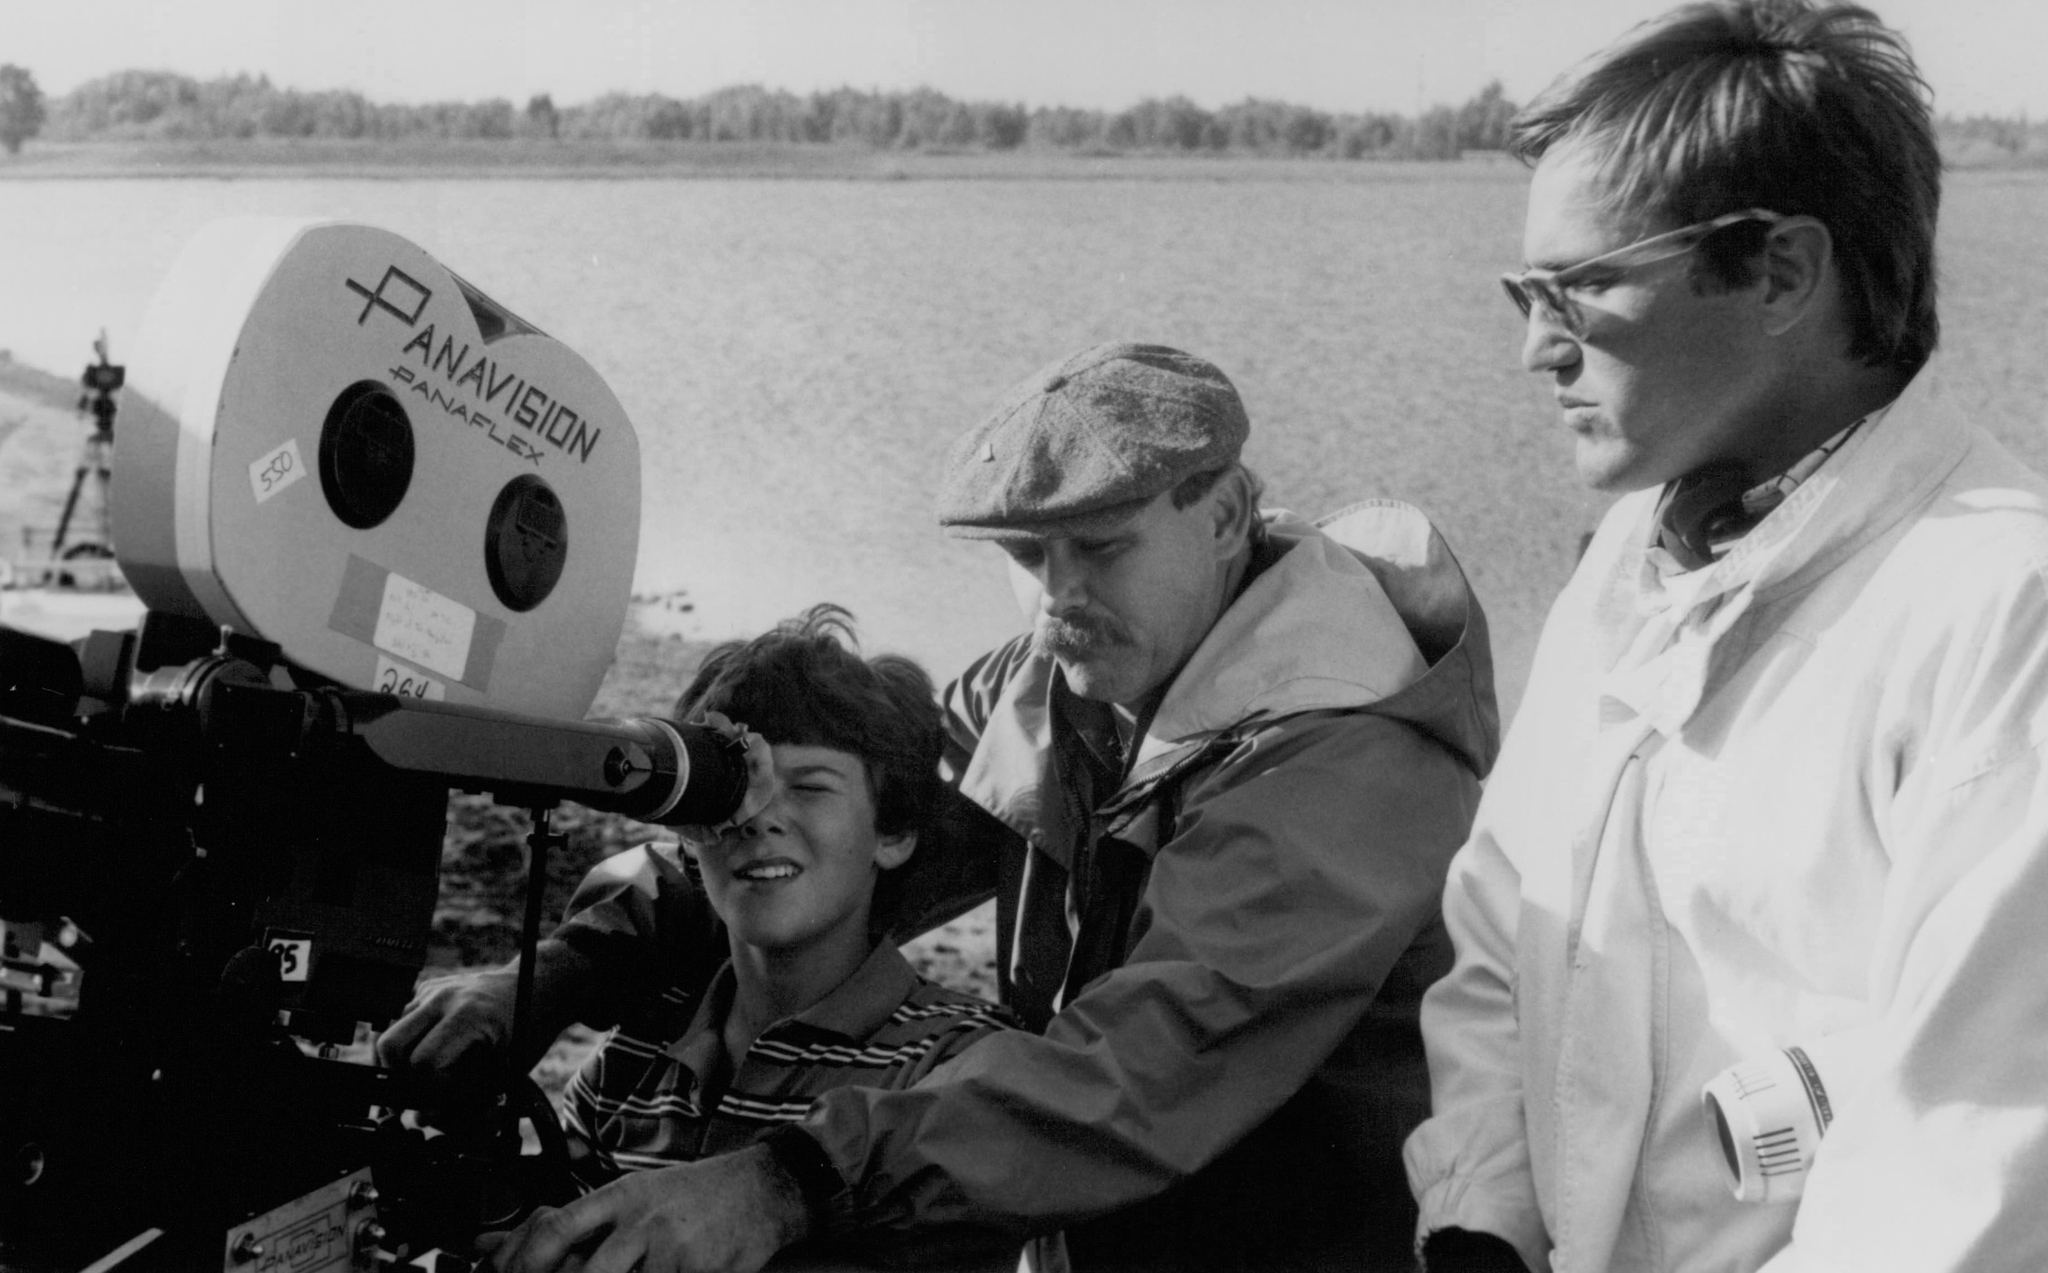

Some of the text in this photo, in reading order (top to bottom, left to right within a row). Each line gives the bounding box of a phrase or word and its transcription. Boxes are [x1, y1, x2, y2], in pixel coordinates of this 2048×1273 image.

[345, 264, 601, 464] PANAVISION
[388, 362, 546, 467] PANAFLEX
[259, 450, 293, 492] 550
[380, 667, 430, 699] 264
[259, 1224, 347, 1272] PANAVISION
